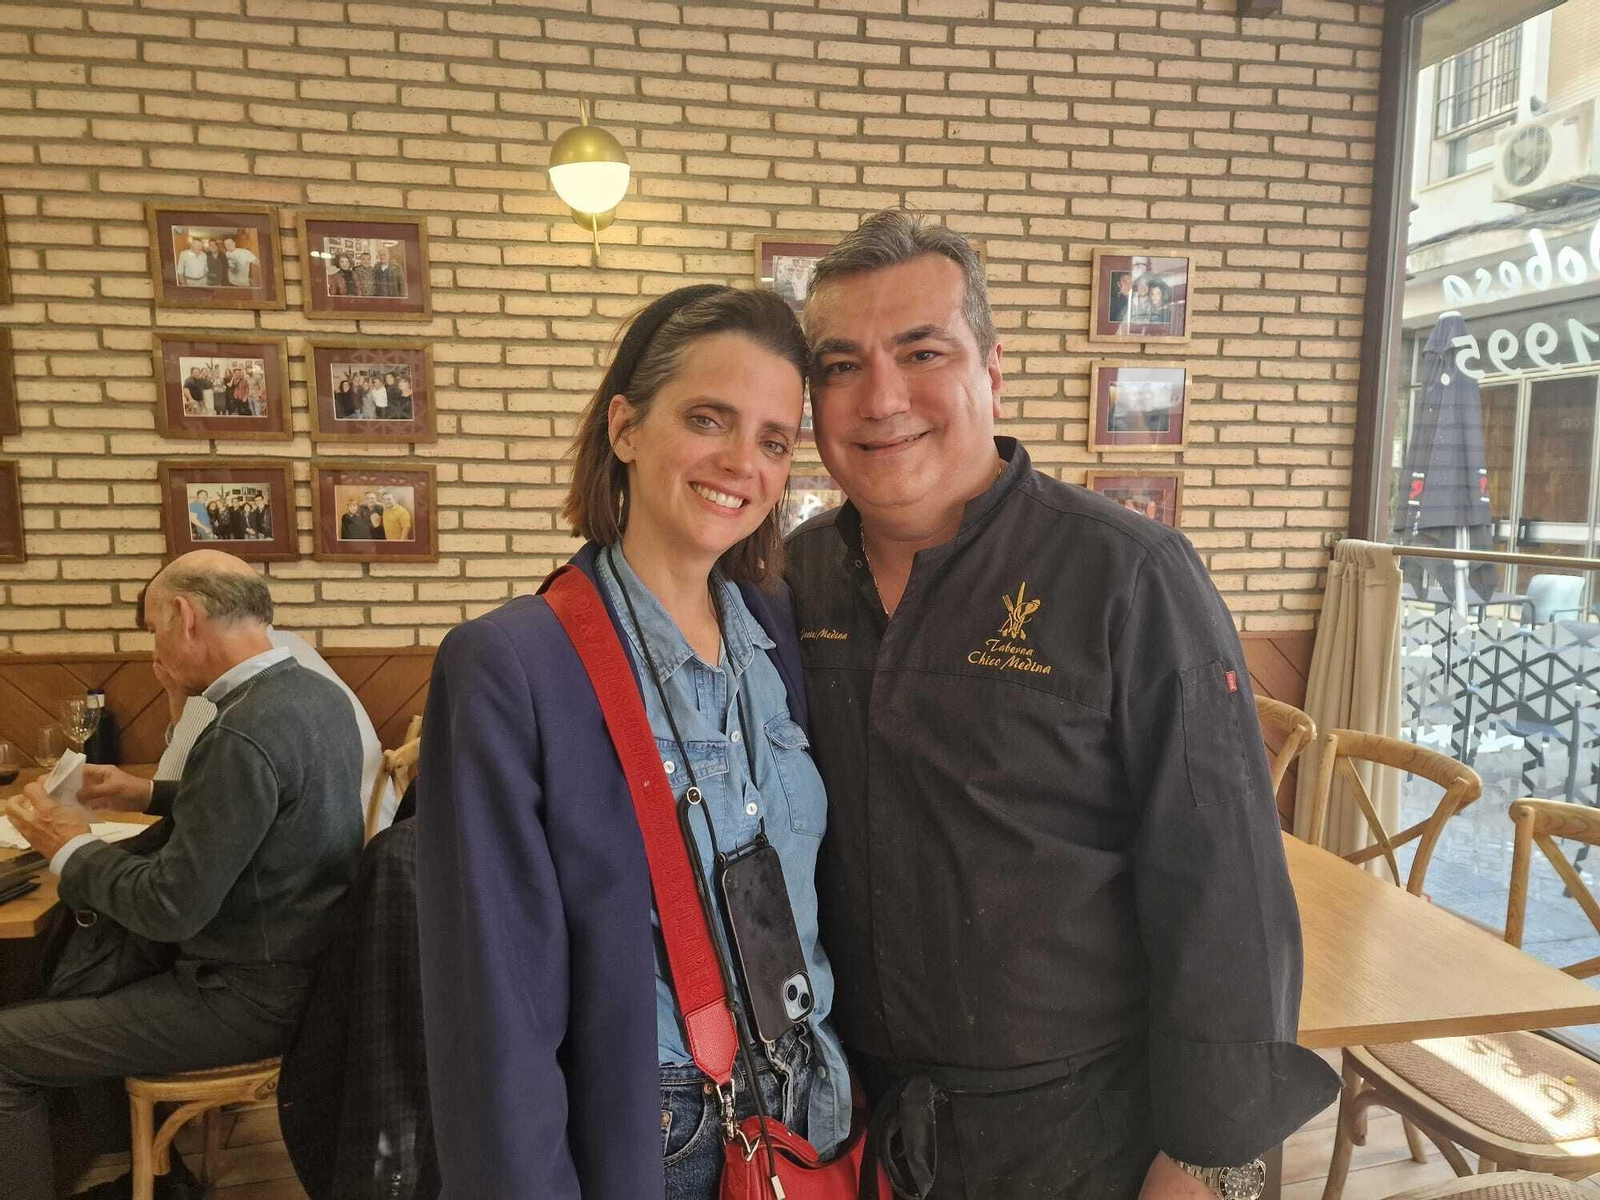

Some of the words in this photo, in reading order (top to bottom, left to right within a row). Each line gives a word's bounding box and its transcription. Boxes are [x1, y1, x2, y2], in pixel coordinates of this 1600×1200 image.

[986, 639, 1034, 657] Taberna
[968, 651, 1002, 667] Chico
[1000, 655, 1052, 675] Medina
